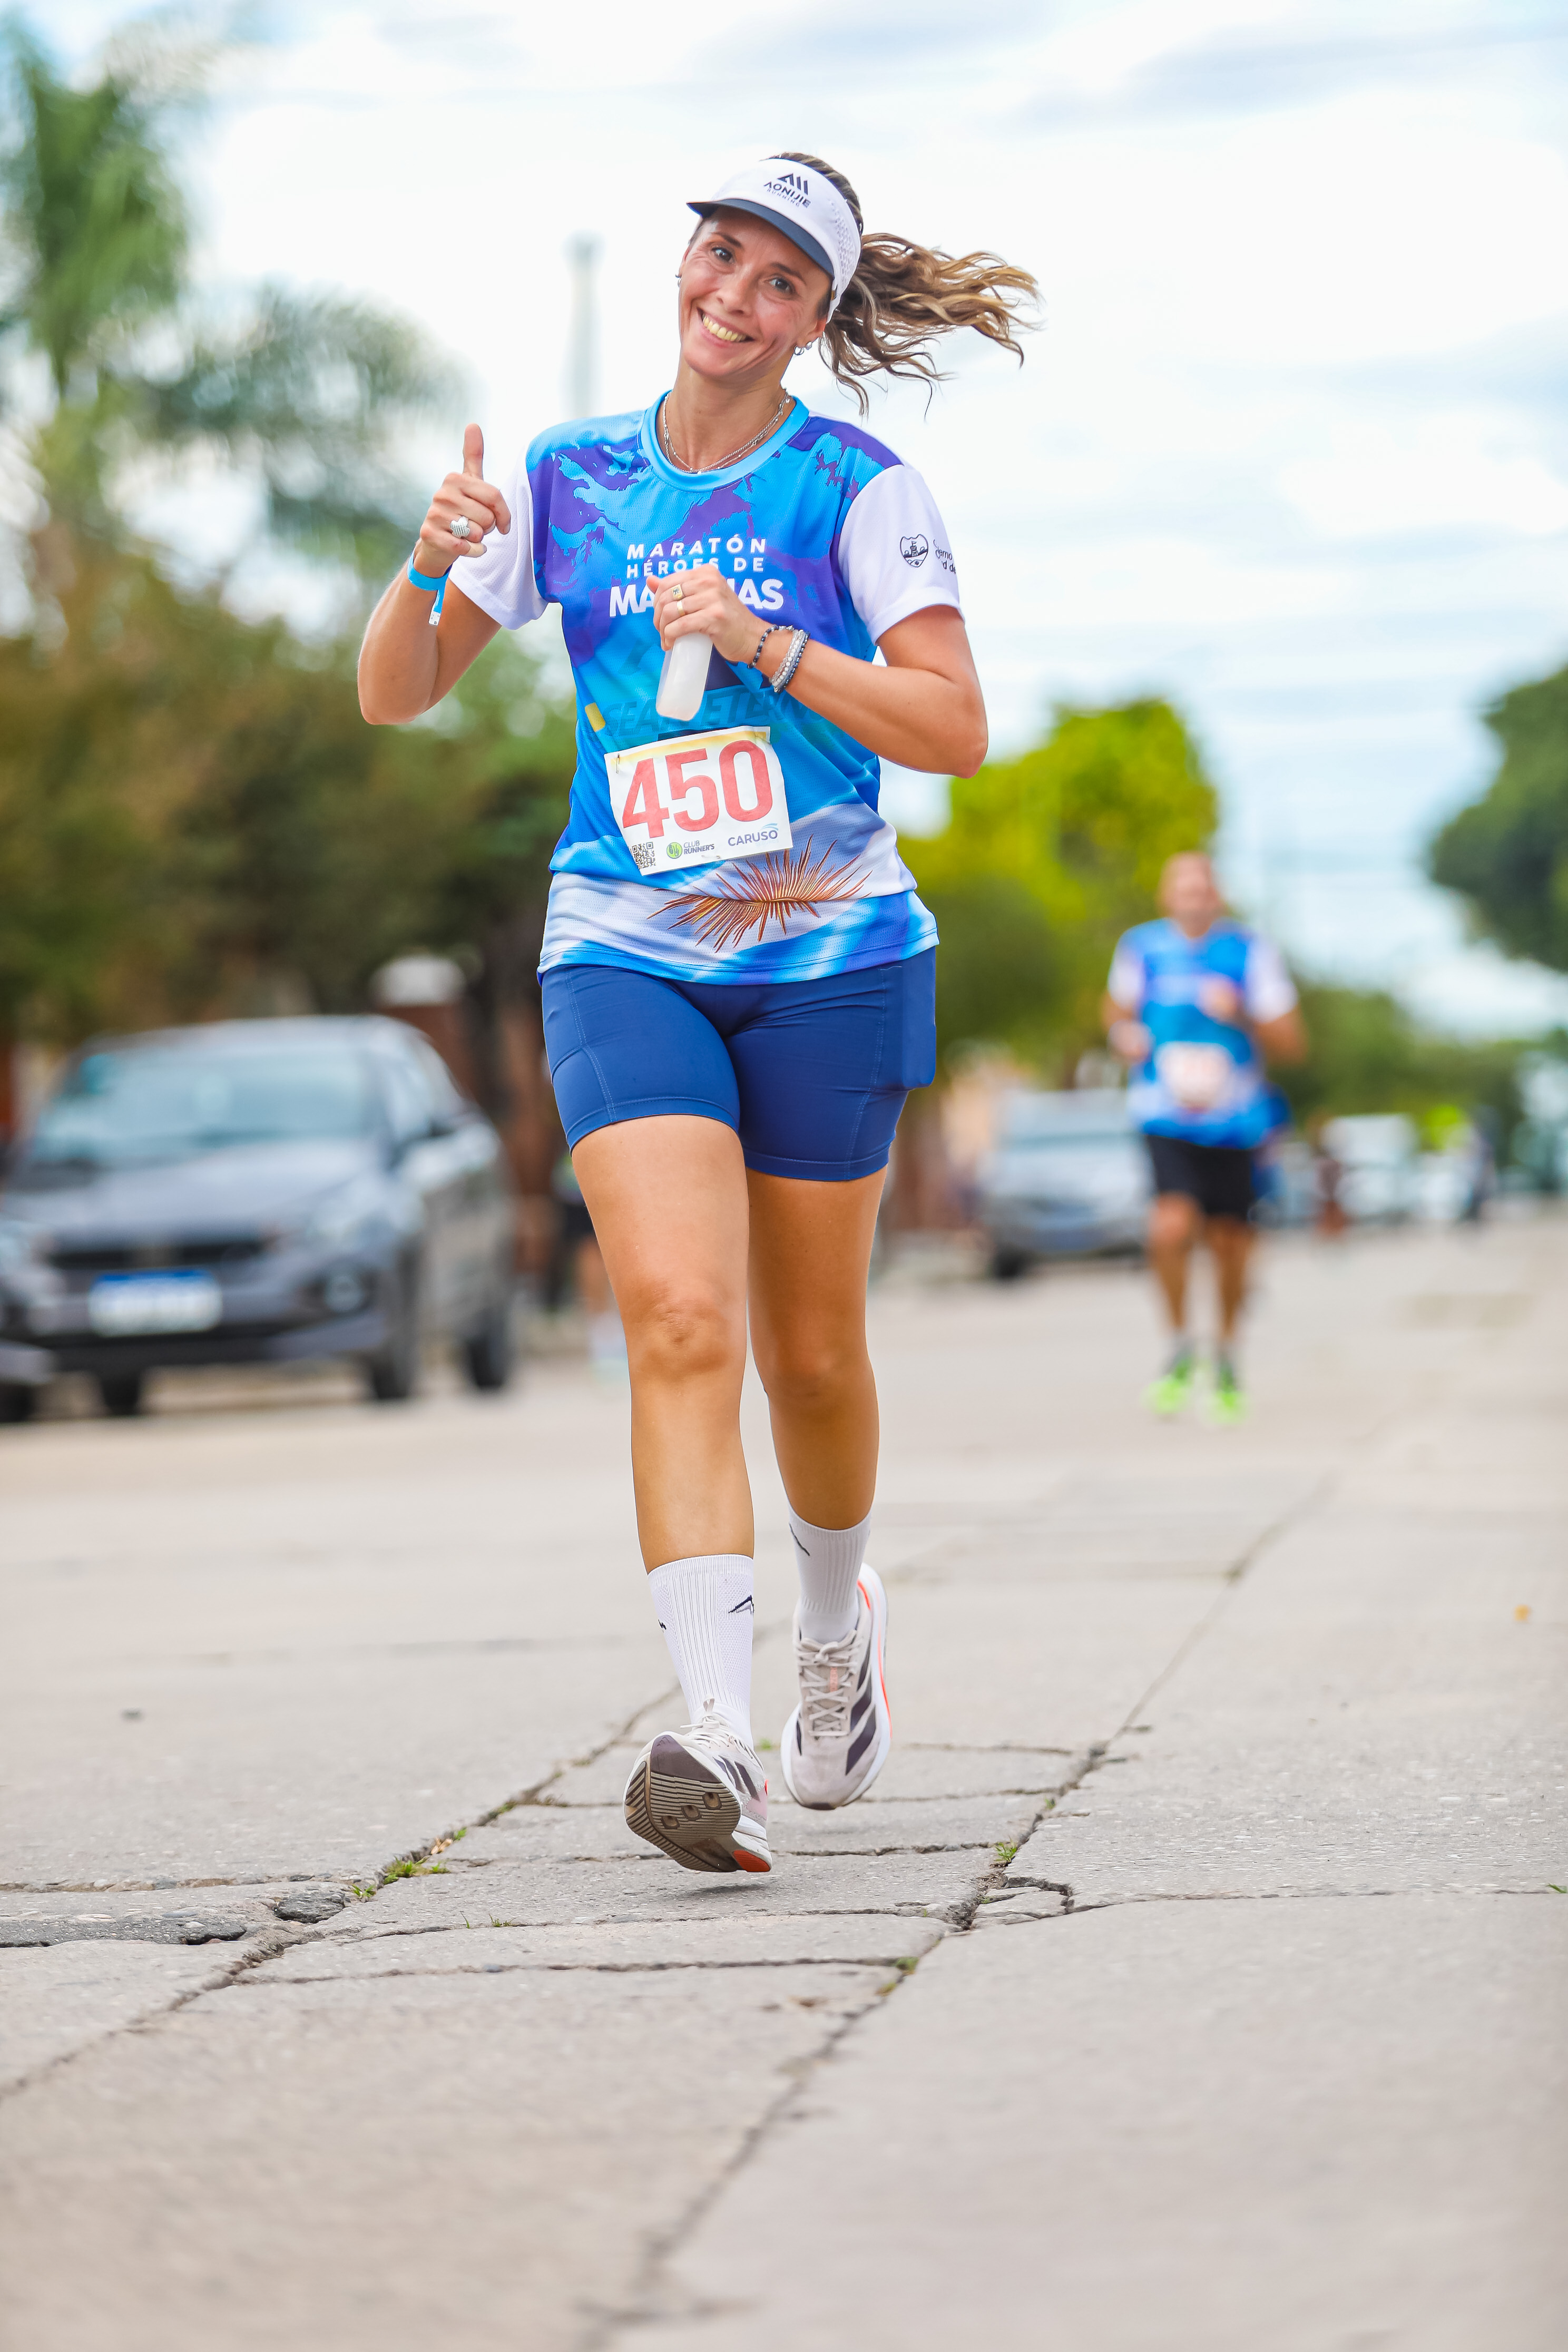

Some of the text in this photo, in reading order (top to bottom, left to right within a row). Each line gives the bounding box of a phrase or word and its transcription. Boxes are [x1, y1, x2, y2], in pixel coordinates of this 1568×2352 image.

[763, 181, 811, 208] AONIJIE
[626, 534, 766, 560] MARATÓN
[733, 557, 764, 573] DE
[609, 577, 784, 618] MAAS
[622, 740, 773, 839] 450
[683, 840, 700, 848] CLUB
[728, 829, 778, 846] CARUSO
[683, 844, 715, 855] RUNNER'S
